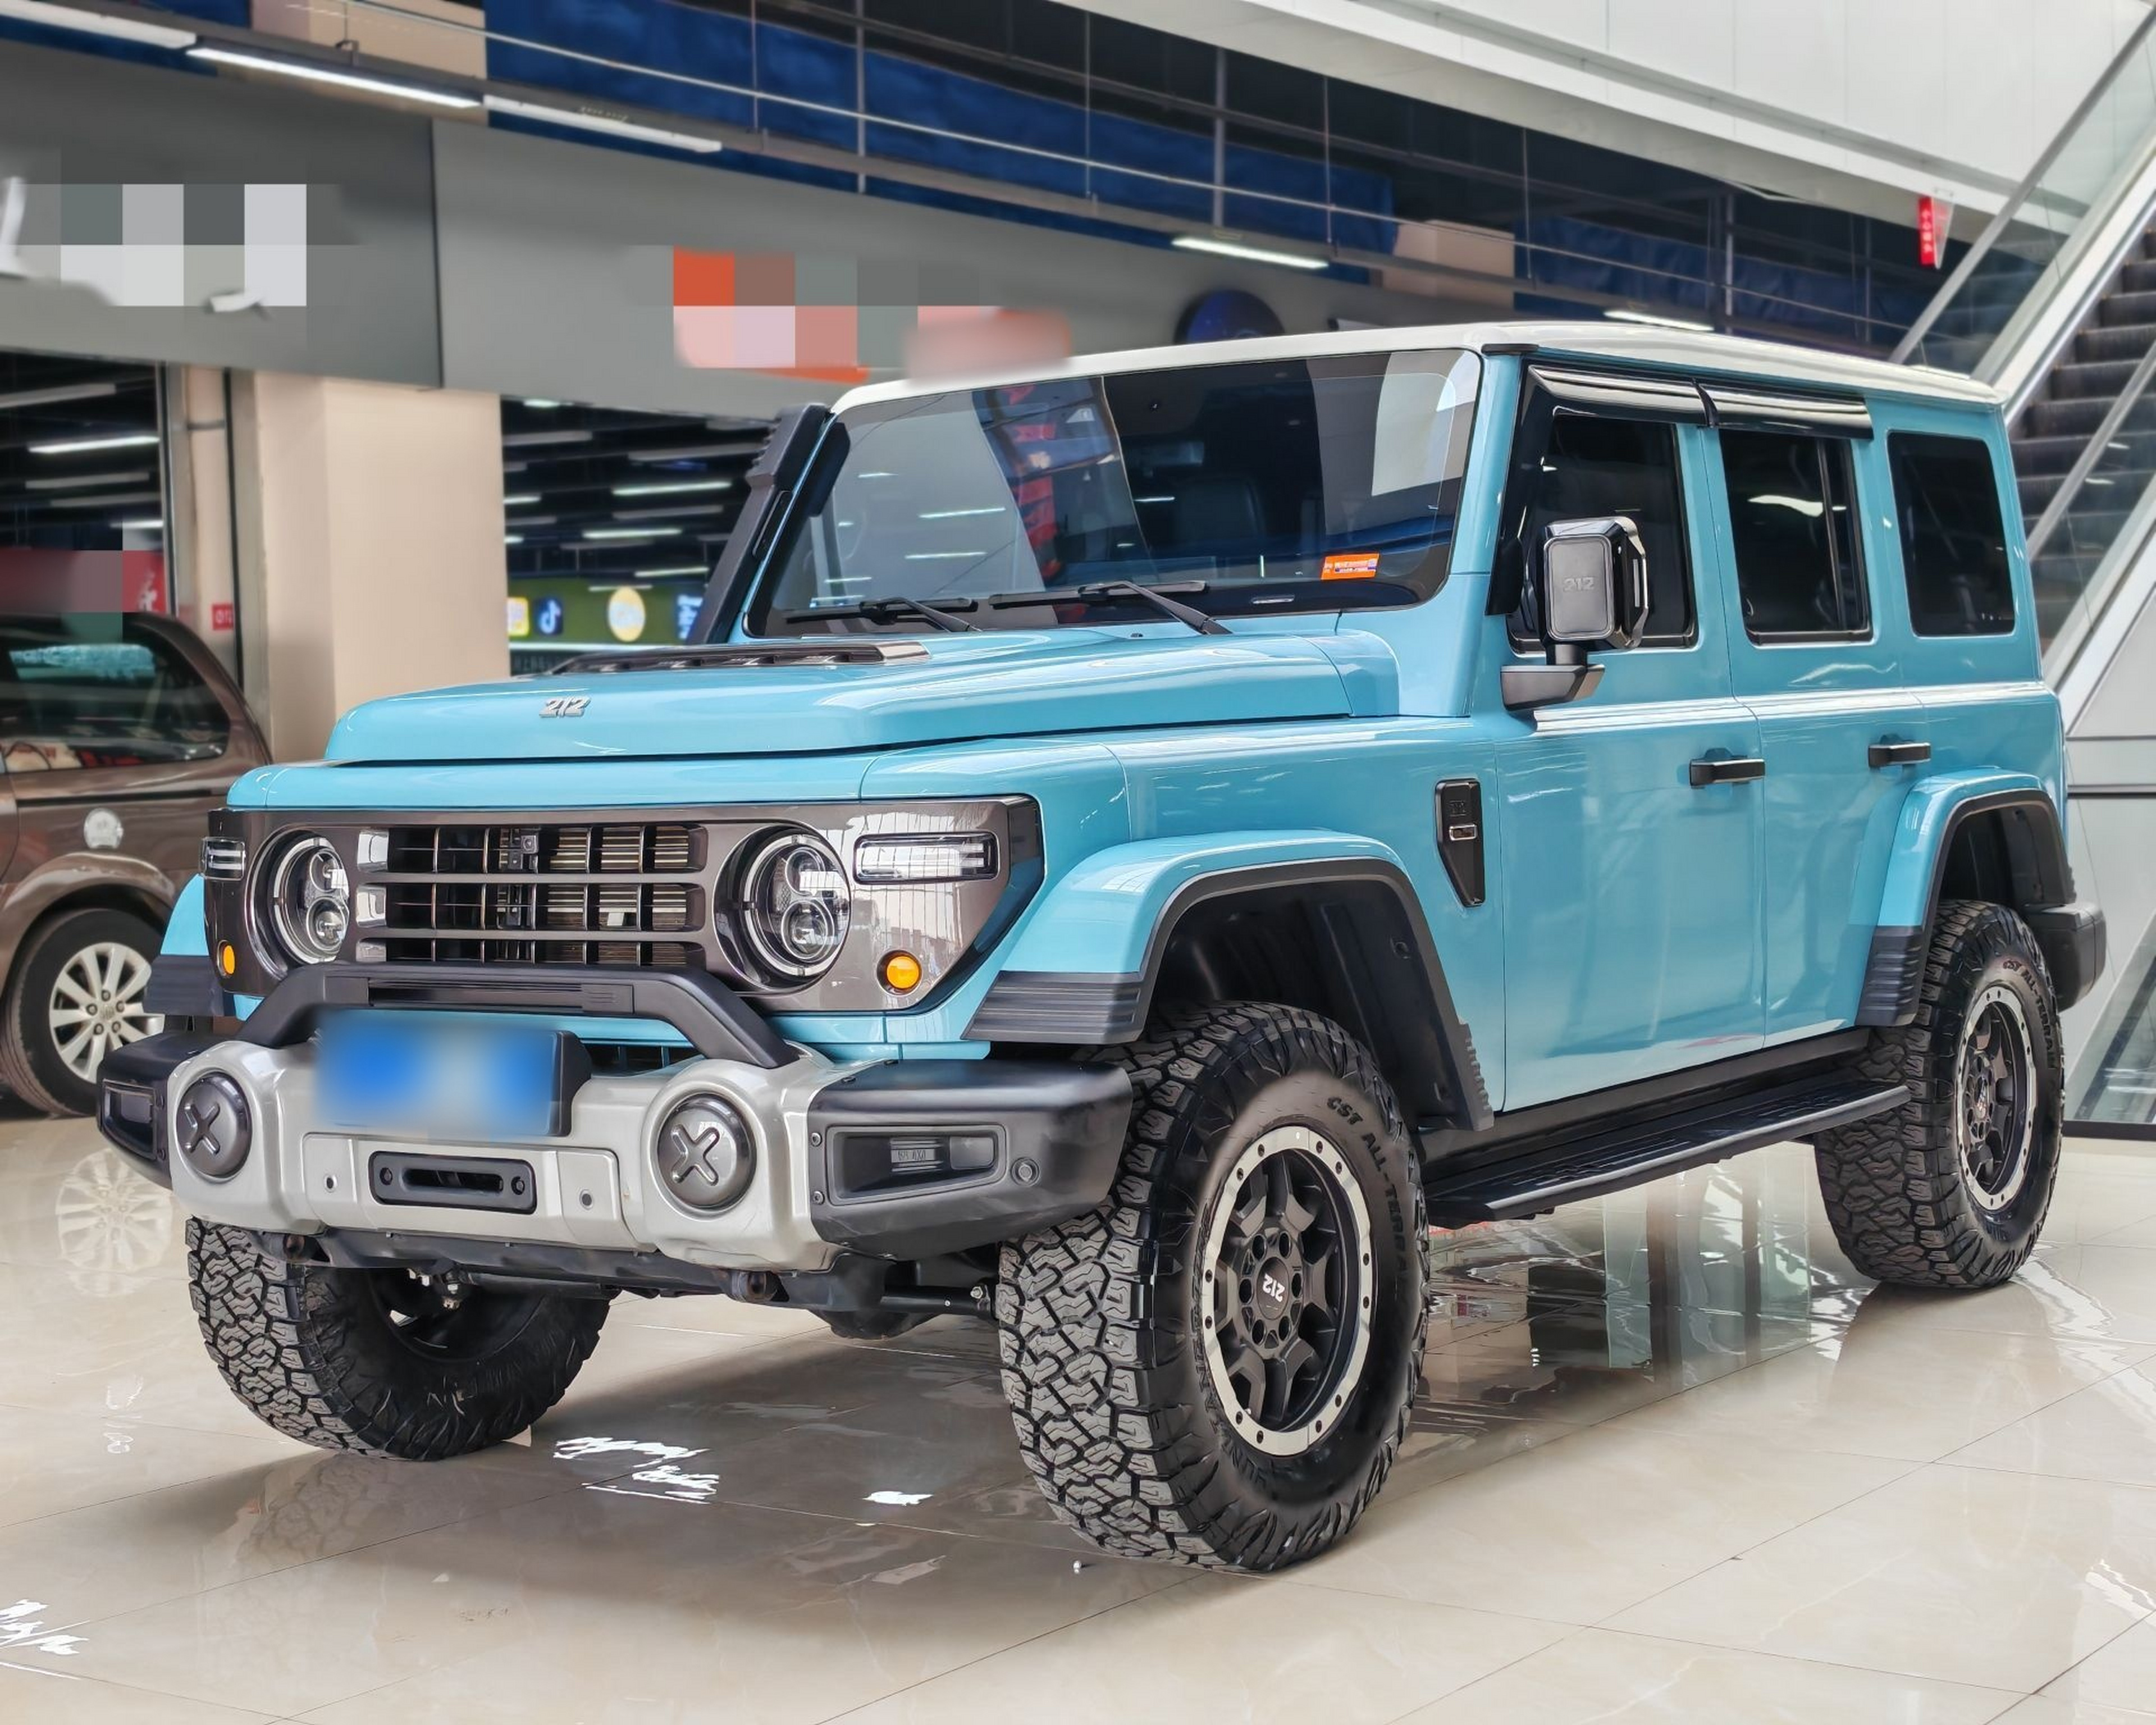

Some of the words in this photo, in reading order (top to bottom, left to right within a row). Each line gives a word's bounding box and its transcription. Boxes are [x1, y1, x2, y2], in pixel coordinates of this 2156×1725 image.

[1563, 576, 1595, 592] 212
[538, 696, 591, 718] 212
[1326, 1097, 1363, 1125] CST
[1262, 1272, 1285, 1303] 212
